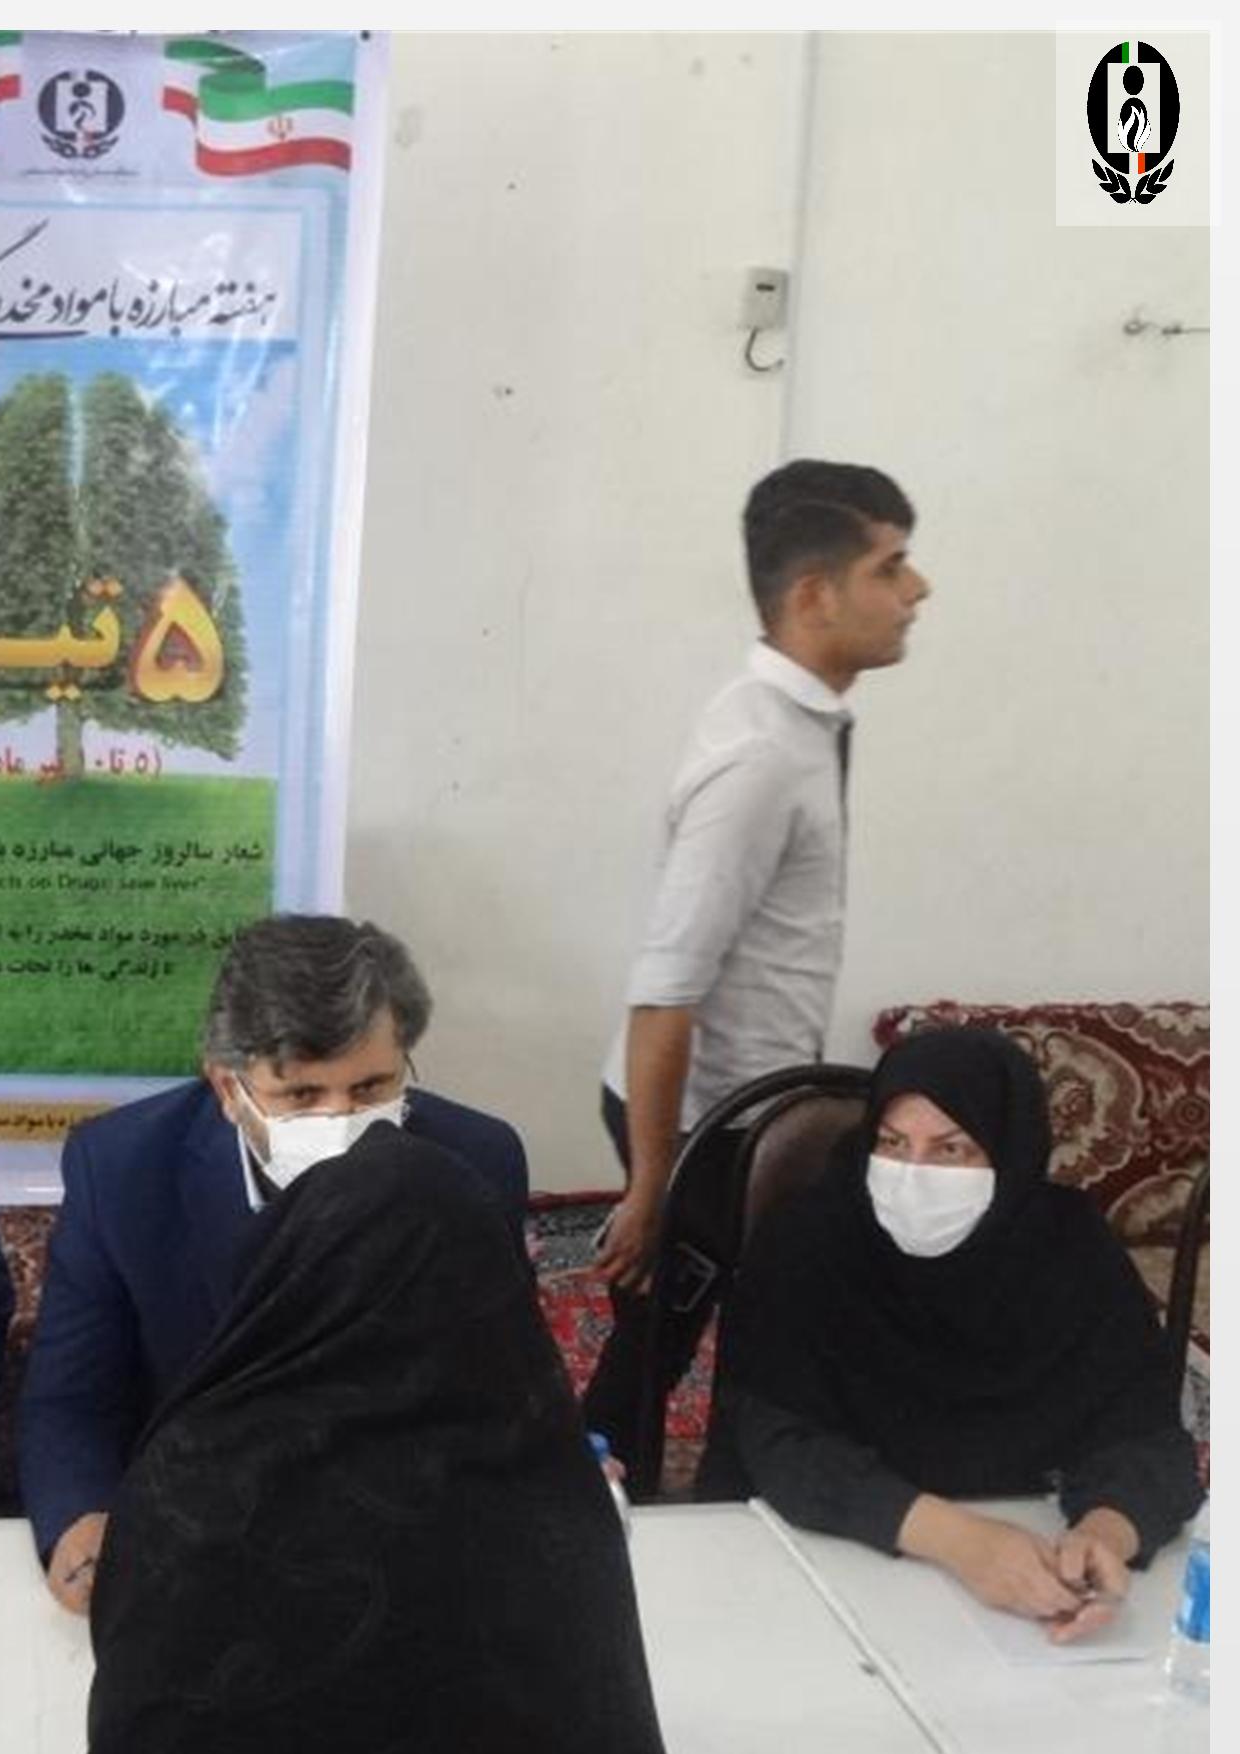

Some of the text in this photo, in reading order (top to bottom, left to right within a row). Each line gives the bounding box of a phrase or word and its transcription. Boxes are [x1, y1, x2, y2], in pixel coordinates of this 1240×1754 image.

[46, 286, 107, 326] مواد
[108, 278, 125, 337] با
[128, 278, 211, 337] مبارزه
[208, 280, 278, 326] هفته
[128, 570, 227, 704] ۵
